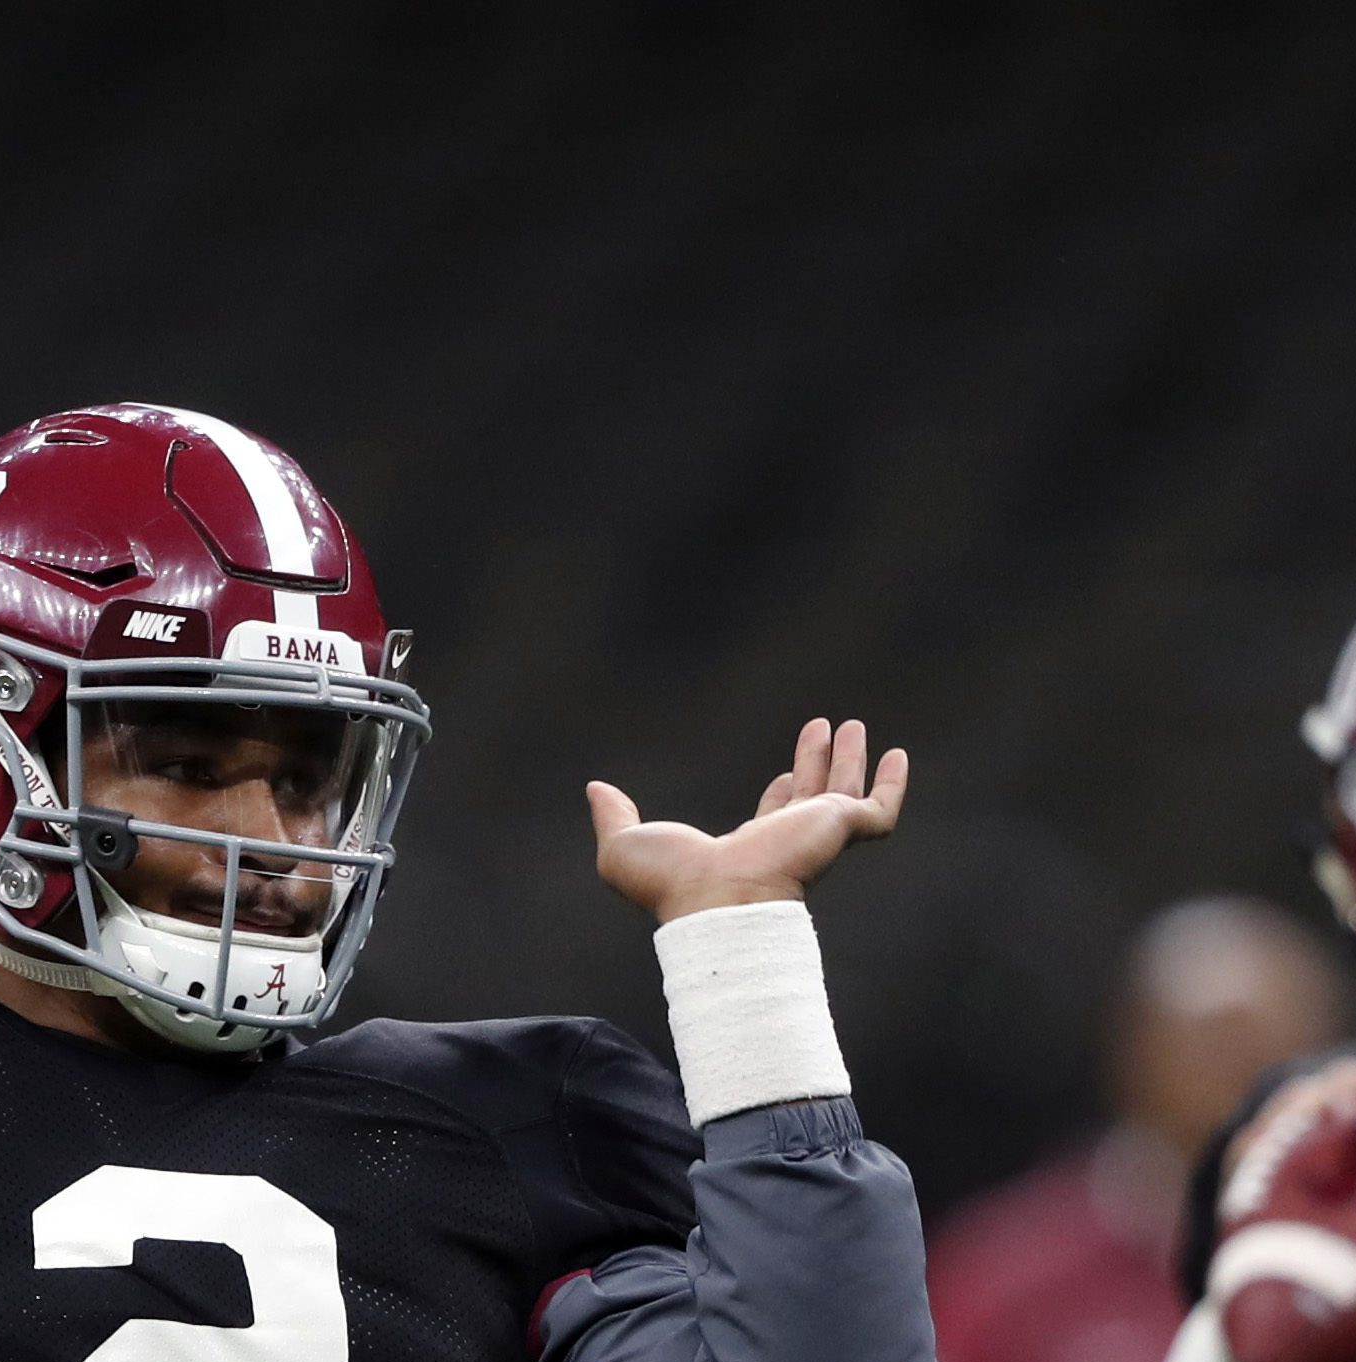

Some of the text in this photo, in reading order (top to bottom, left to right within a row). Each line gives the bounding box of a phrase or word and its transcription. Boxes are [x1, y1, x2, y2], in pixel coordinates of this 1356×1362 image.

[122, 610, 187, 643] NIKE
[266, 635, 340, 666] BAMA
[254, 963, 286, 1002] A
